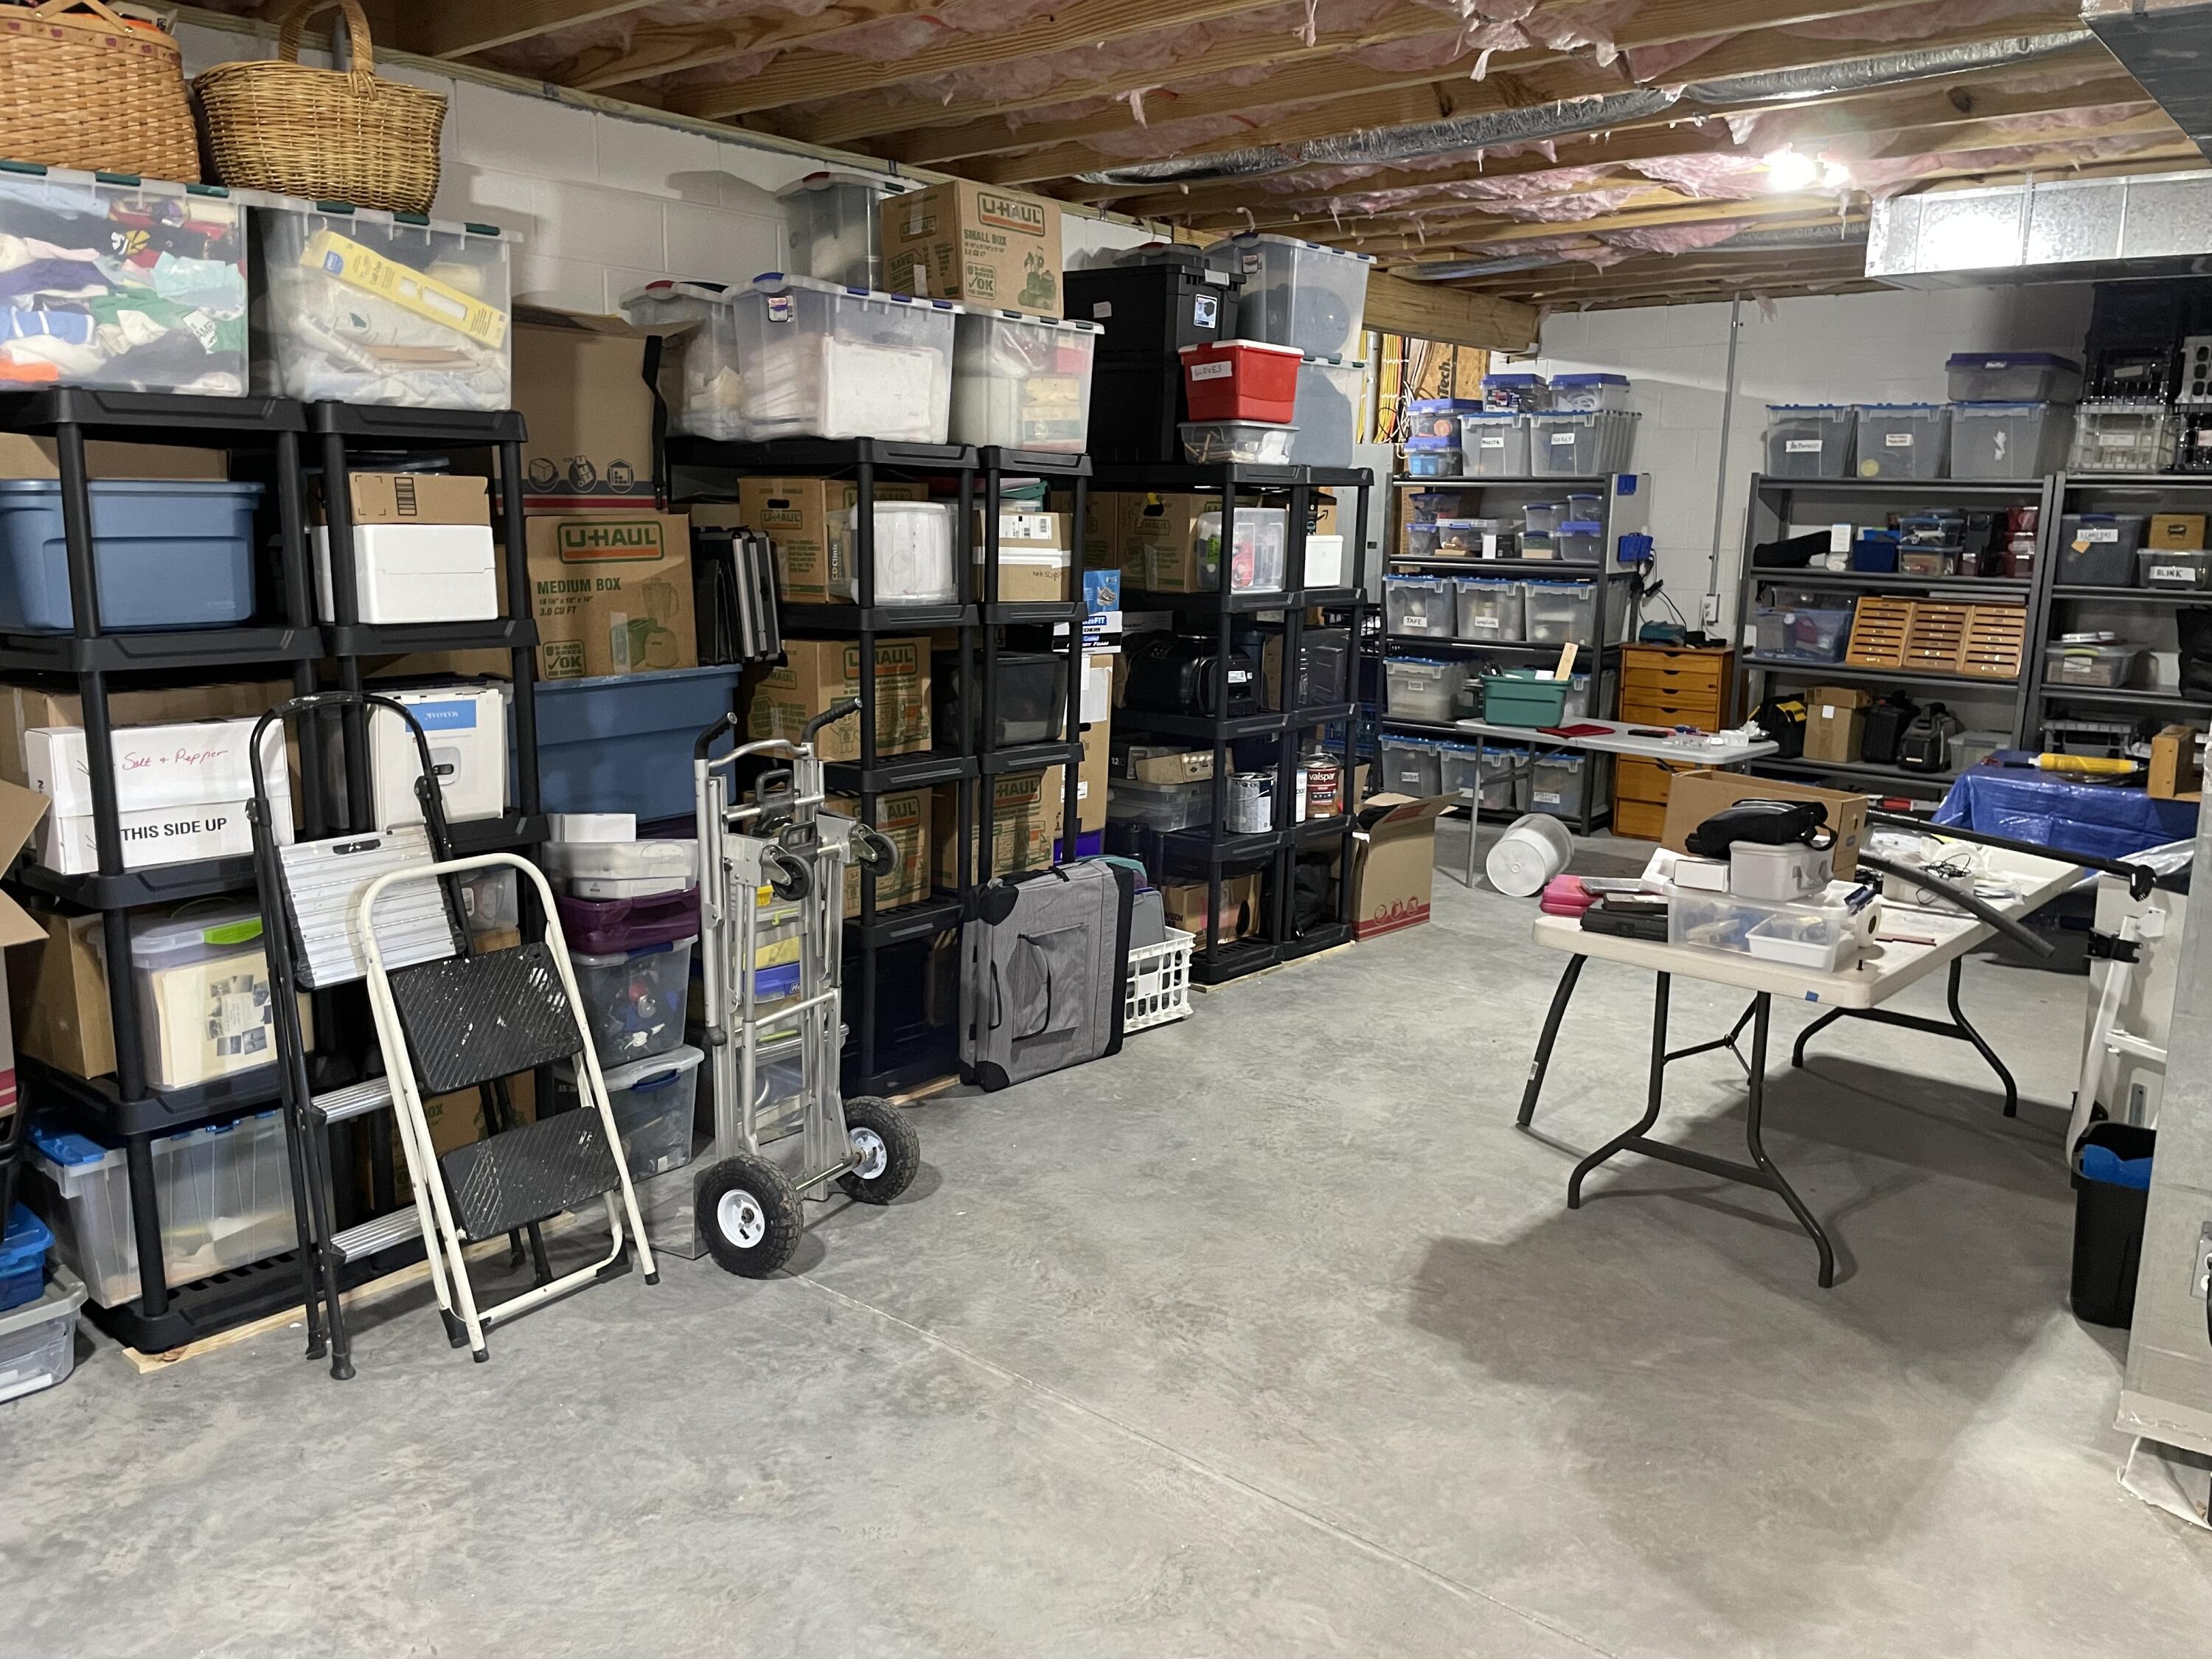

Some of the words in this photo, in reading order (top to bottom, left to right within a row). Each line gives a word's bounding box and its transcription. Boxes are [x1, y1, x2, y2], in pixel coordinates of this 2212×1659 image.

[982, 198, 1041, 224] U-HAUL
[964, 229, 990, 243] SMALL
[992, 234, 1006, 246] BOX
[977, 279, 994, 291] OK
[1194, 364, 1222, 377] GLOVES
[763, 512, 800, 522] U-HAUL
[565, 528, 656, 547] U-HAUL
[2156, 568, 2183, 579] BLINK
[538, 578, 591, 594] MEDIUM
[596, 577, 621, 591] BOX
[540, 608, 552, 616] 3.0
[554, 607, 565, 615] CU
[566, 605, 577, 614] FT
[1406, 617, 1422, 625] TAPE
[559, 655, 582, 669] OK
[849, 649, 914, 667] UAUL
[425, 711, 459, 719] MAXOAK
[122, 752, 152, 771] Salt
[175, 748, 229, 765] Pepper
[1308, 772, 1335, 782] valspar
[995, 780, 1038, 798] -HAUL
[120, 825, 159, 841] THIS
[164, 820, 201, 836] SIDE
[205, 817, 227, 832] UP
[427, 1104, 444, 1119] OX
